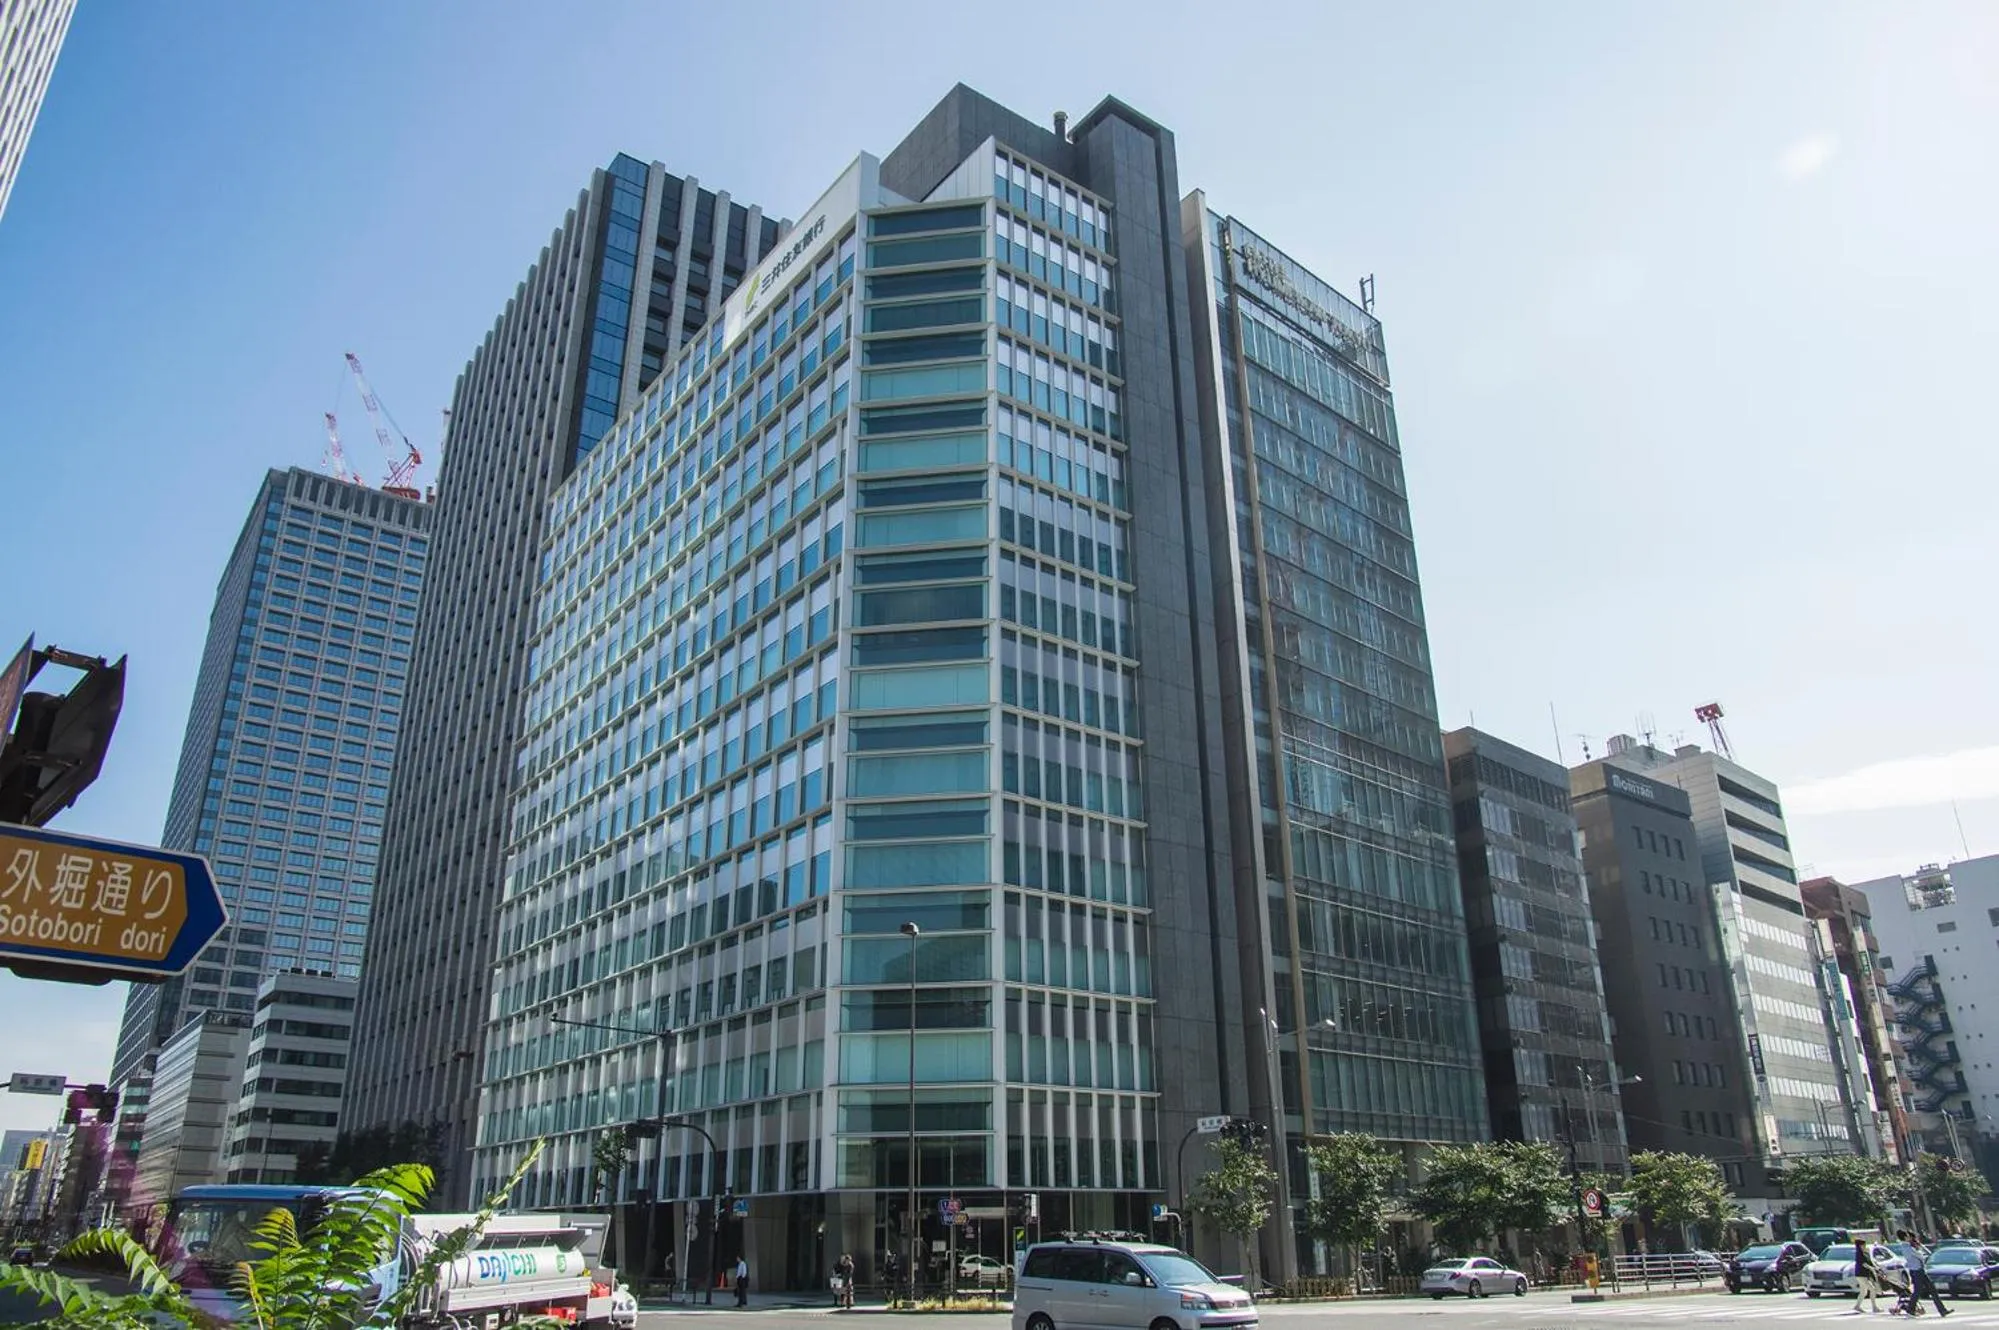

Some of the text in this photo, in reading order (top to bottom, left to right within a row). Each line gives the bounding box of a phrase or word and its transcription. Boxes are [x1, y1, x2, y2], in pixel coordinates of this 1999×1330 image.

[1, 848, 173, 920] 外堀通り
[0, 904, 167, 953] Sotobori dori
